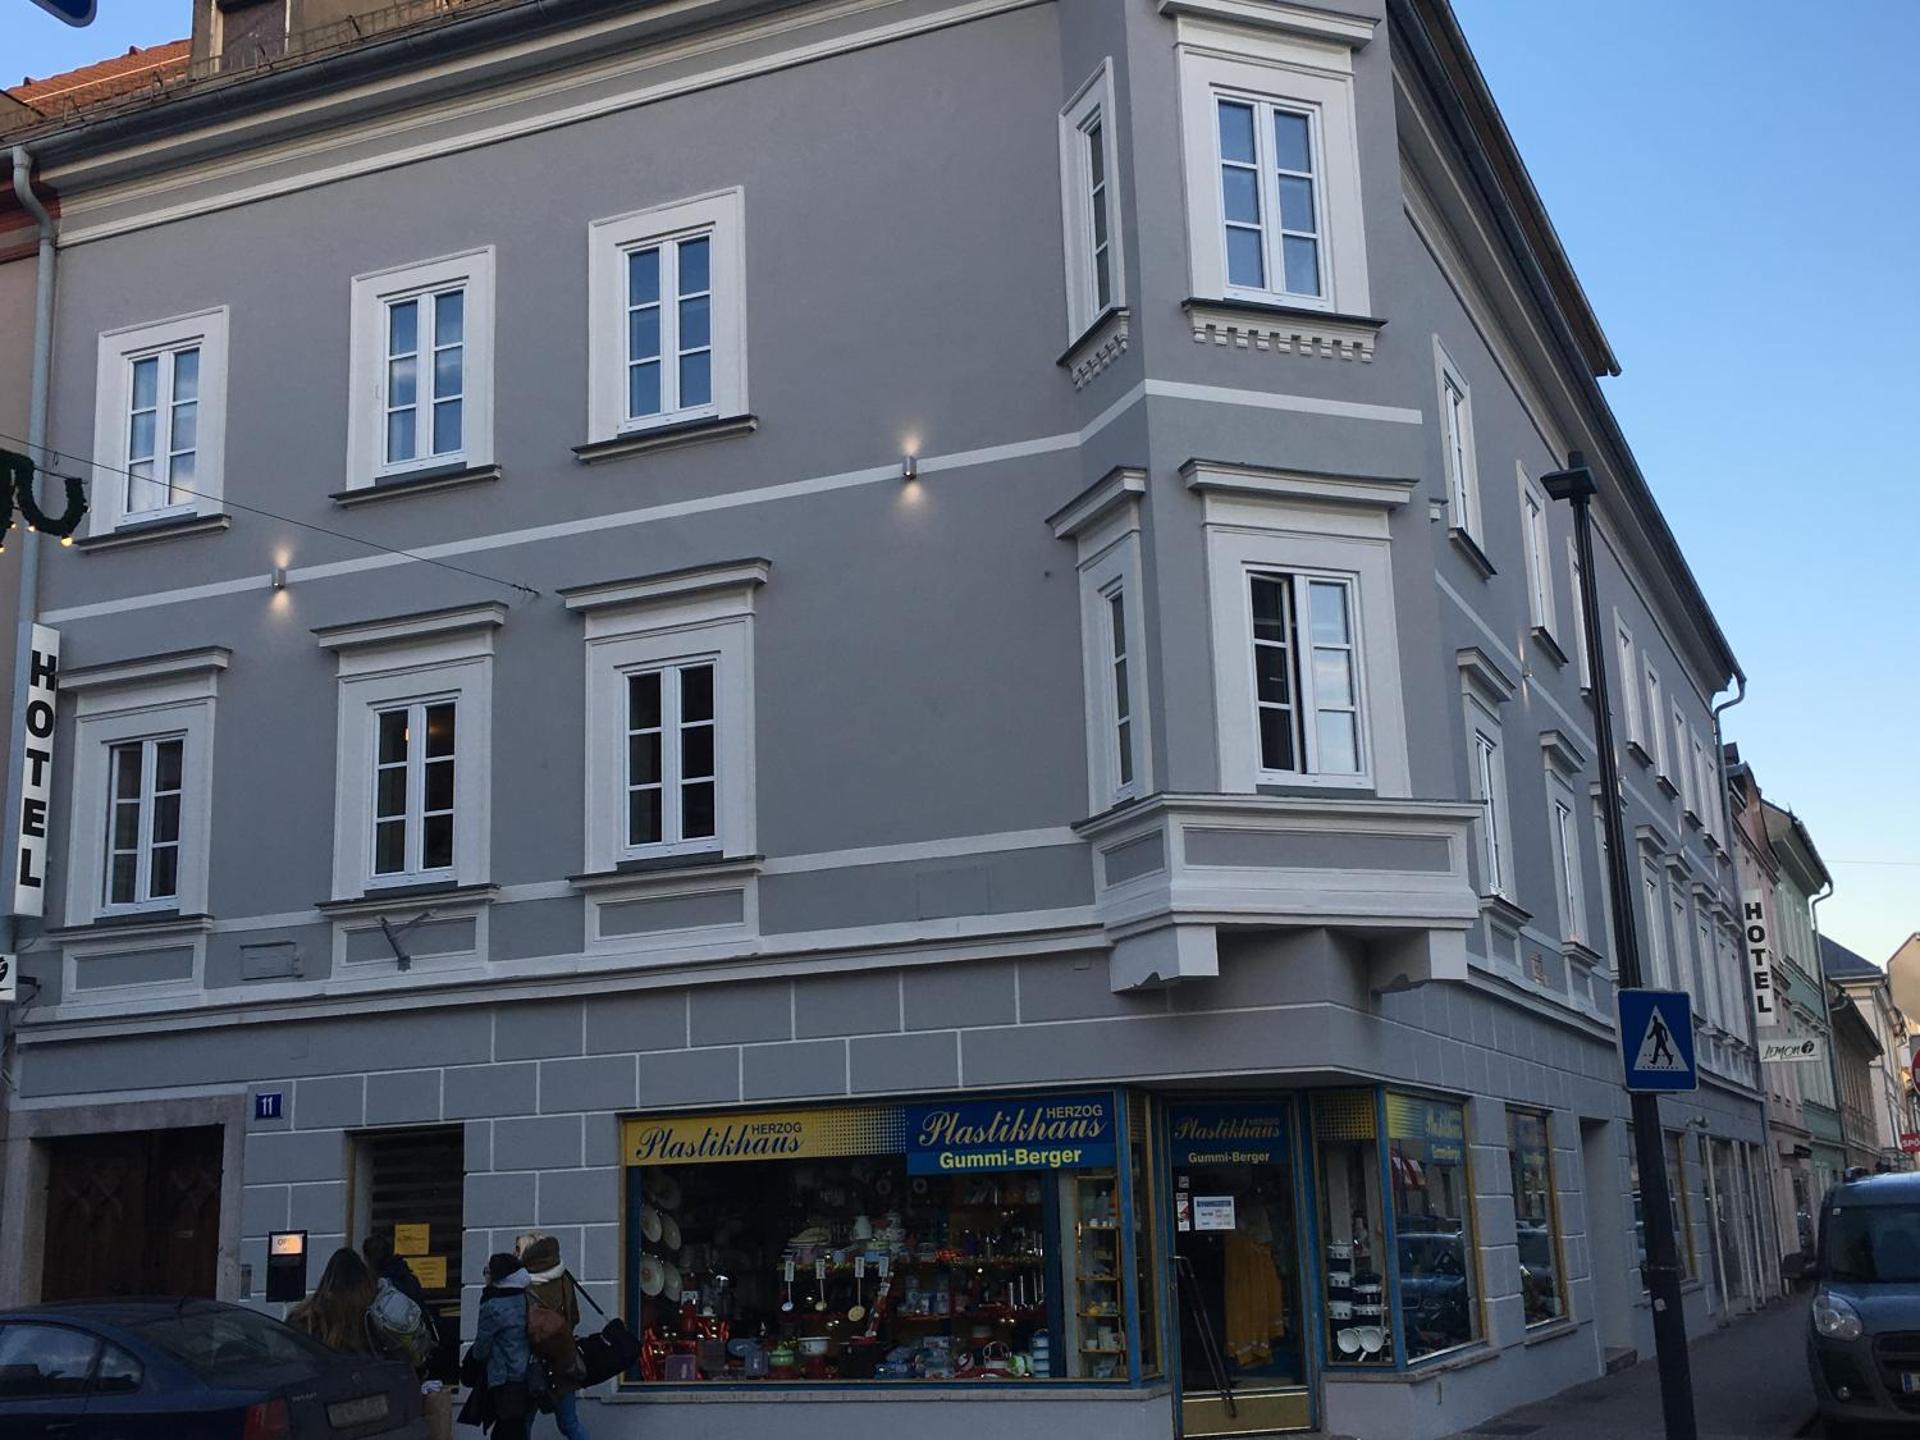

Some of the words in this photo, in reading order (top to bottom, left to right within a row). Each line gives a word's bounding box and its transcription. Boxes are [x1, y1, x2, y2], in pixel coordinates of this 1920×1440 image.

[20, 650, 57, 888] HOTEL
[1744, 902, 1772, 1013] HOTEL
[262, 1097, 273, 1115] 11
[1046, 1105, 1103, 1119] HERZOG
[751, 1122, 802, 1135] HERZOG
[919, 1108, 1107, 1146] Plastikhaus
[636, 1124, 805, 1160] Plastikhaus
[939, 1149, 1082, 1168] Gummi-Berger
[1188, 1151, 1270, 1164] Gummi-Berger
